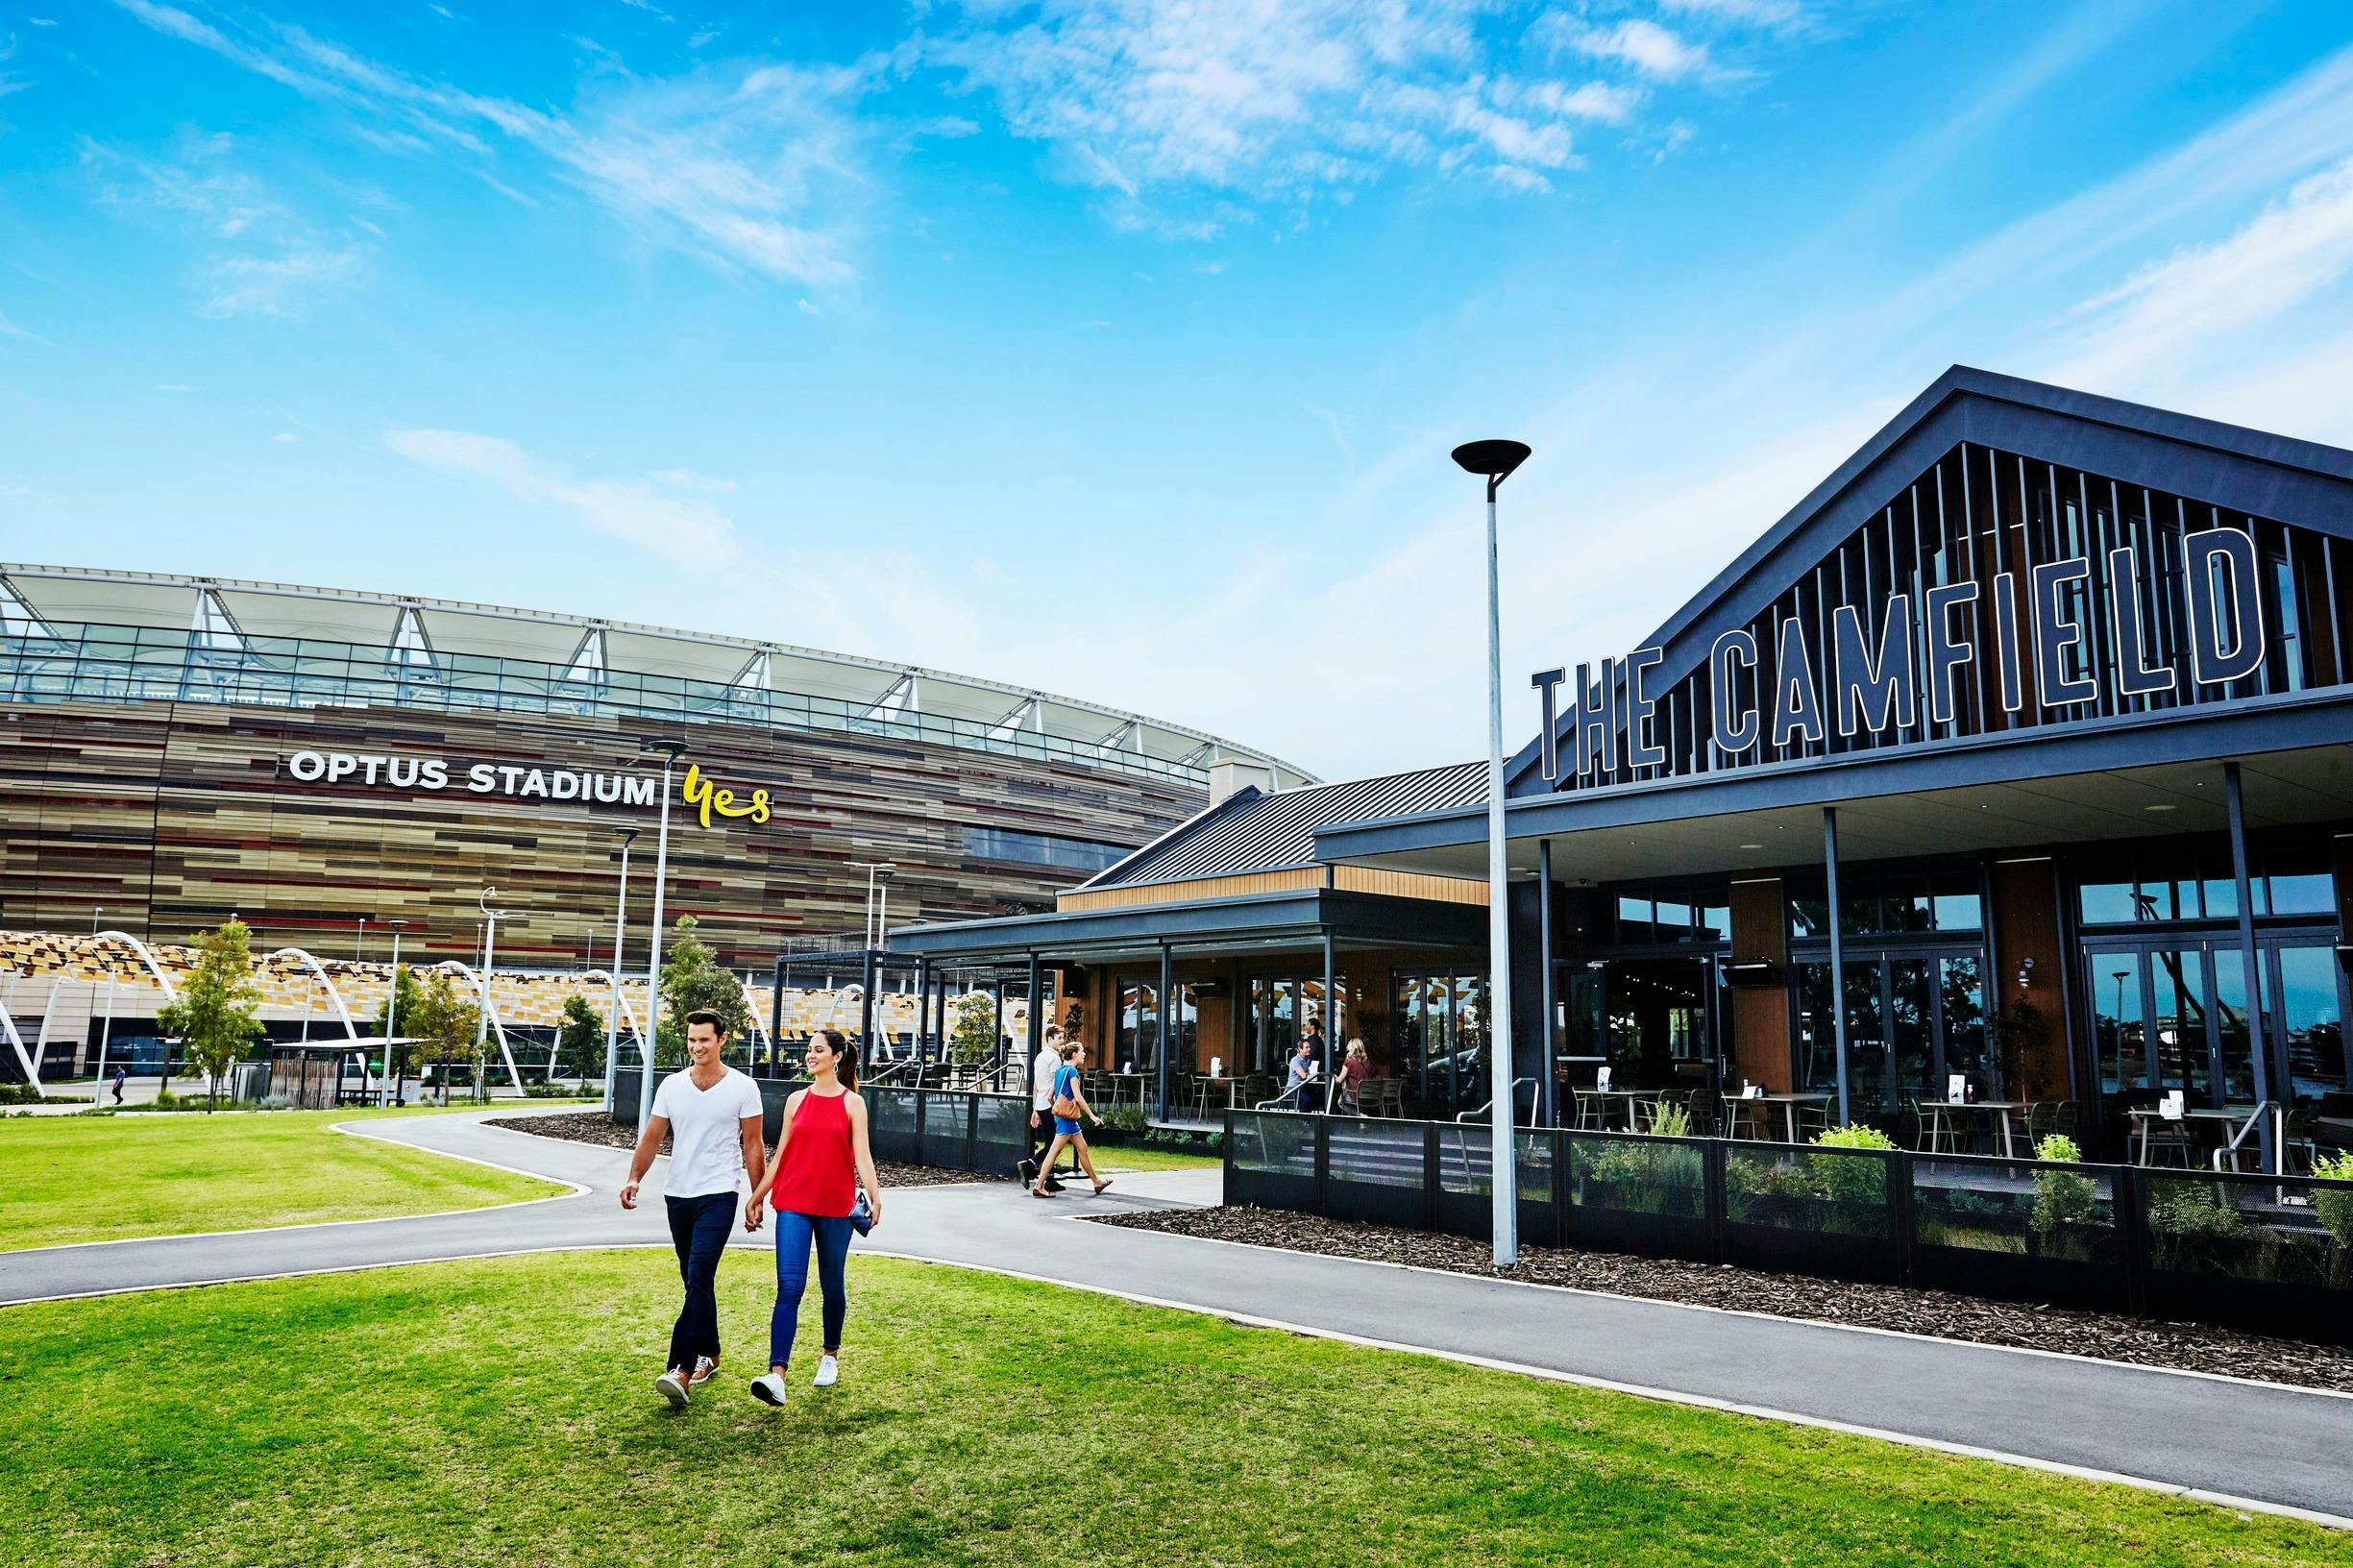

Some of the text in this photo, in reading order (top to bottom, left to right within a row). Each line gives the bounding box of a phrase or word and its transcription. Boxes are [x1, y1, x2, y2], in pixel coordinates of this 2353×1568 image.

[1532, 527, 2267, 781] THE CAMFIELD
[290, 750, 449, 790] OPTUS
[467, 764, 655, 805] STADIUM
